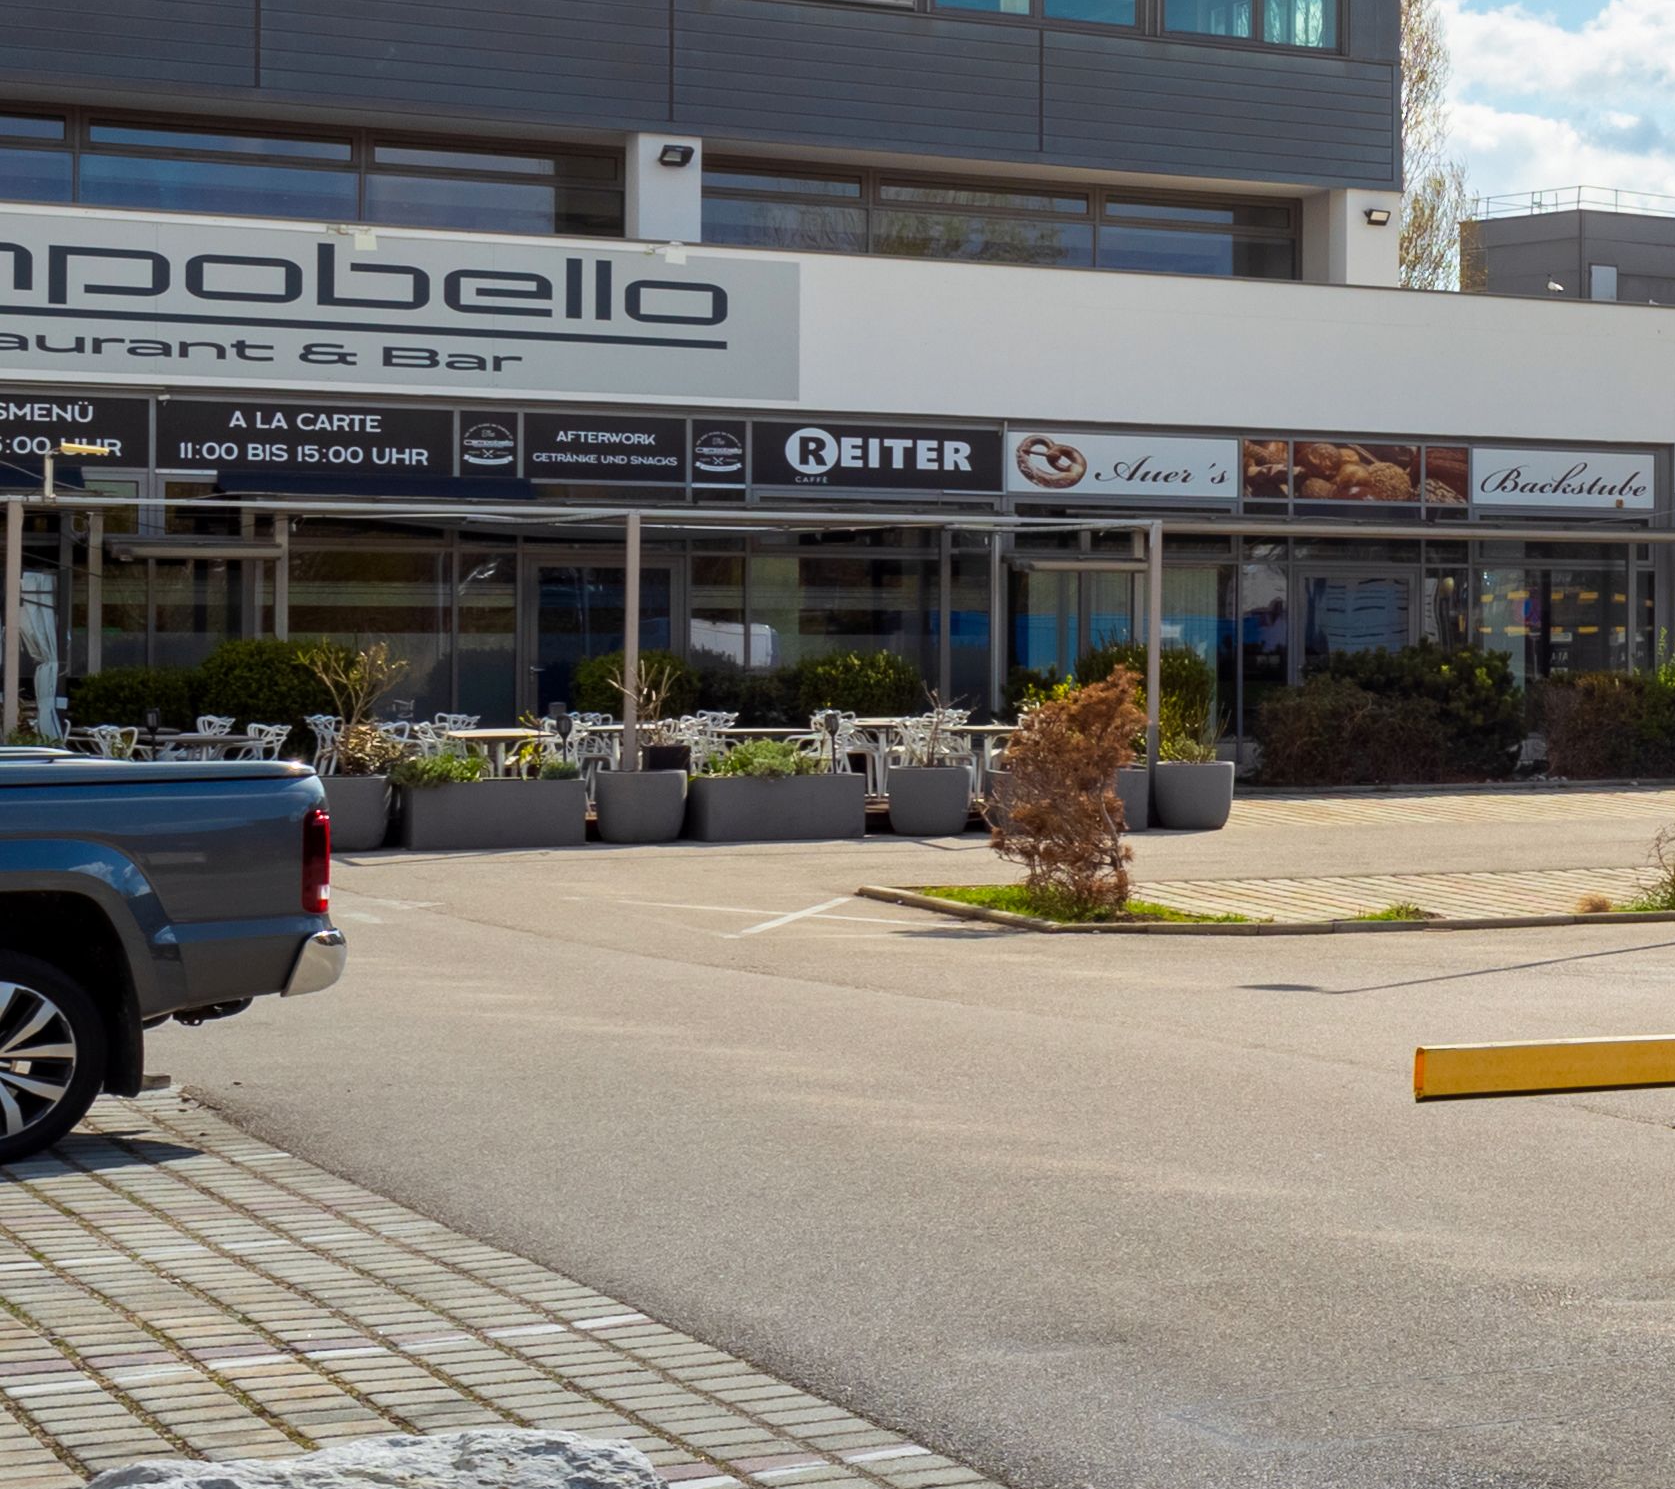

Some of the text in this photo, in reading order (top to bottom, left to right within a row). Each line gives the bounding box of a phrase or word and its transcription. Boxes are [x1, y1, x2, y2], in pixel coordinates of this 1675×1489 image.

[0, 241, 729, 326] pobello
[299, 343, 357, 366] &
[383, 346, 523, 372] Bar
[229, 411, 382, 432] A LA CARTE
[0, 435, 51, 456] :00
[556, 430, 656, 446] AFTERWORK
[179, 442, 429, 466] 11:00 BIS 15:00 UHR
[532, 452, 678, 467] GETRÄNKE UND SNACKS
[798, 435, 972, 471] REITER
[1480, 462, 1648, 497] Backstube
